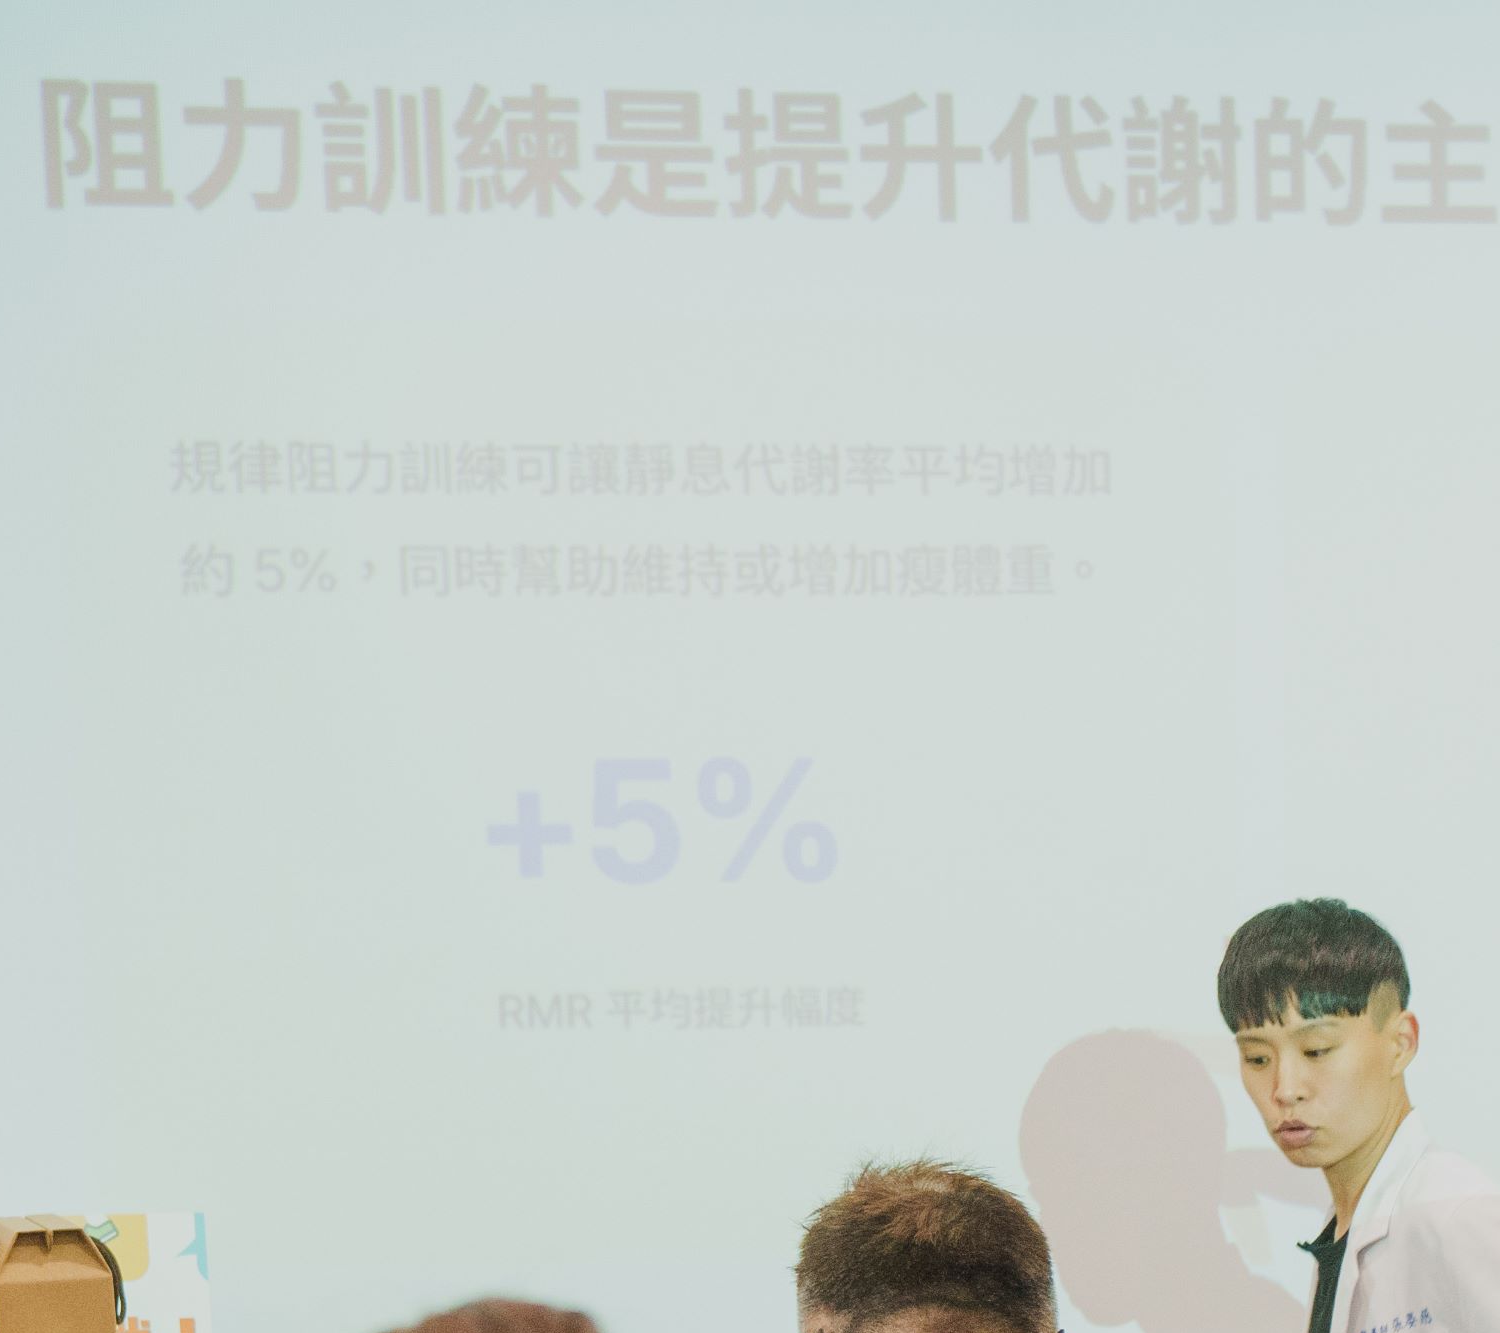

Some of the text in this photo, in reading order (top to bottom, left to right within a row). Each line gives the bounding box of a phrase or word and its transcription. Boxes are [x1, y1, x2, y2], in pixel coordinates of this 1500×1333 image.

[170, 439, 1112, 497] 規律阻力訓練可讓靜息代謝率平均增加
[181, 543, 234, 598] 約
[486, 756, 839, 886] +5%
[498, 986, 866, 1031] RMR 平均提升幅度
